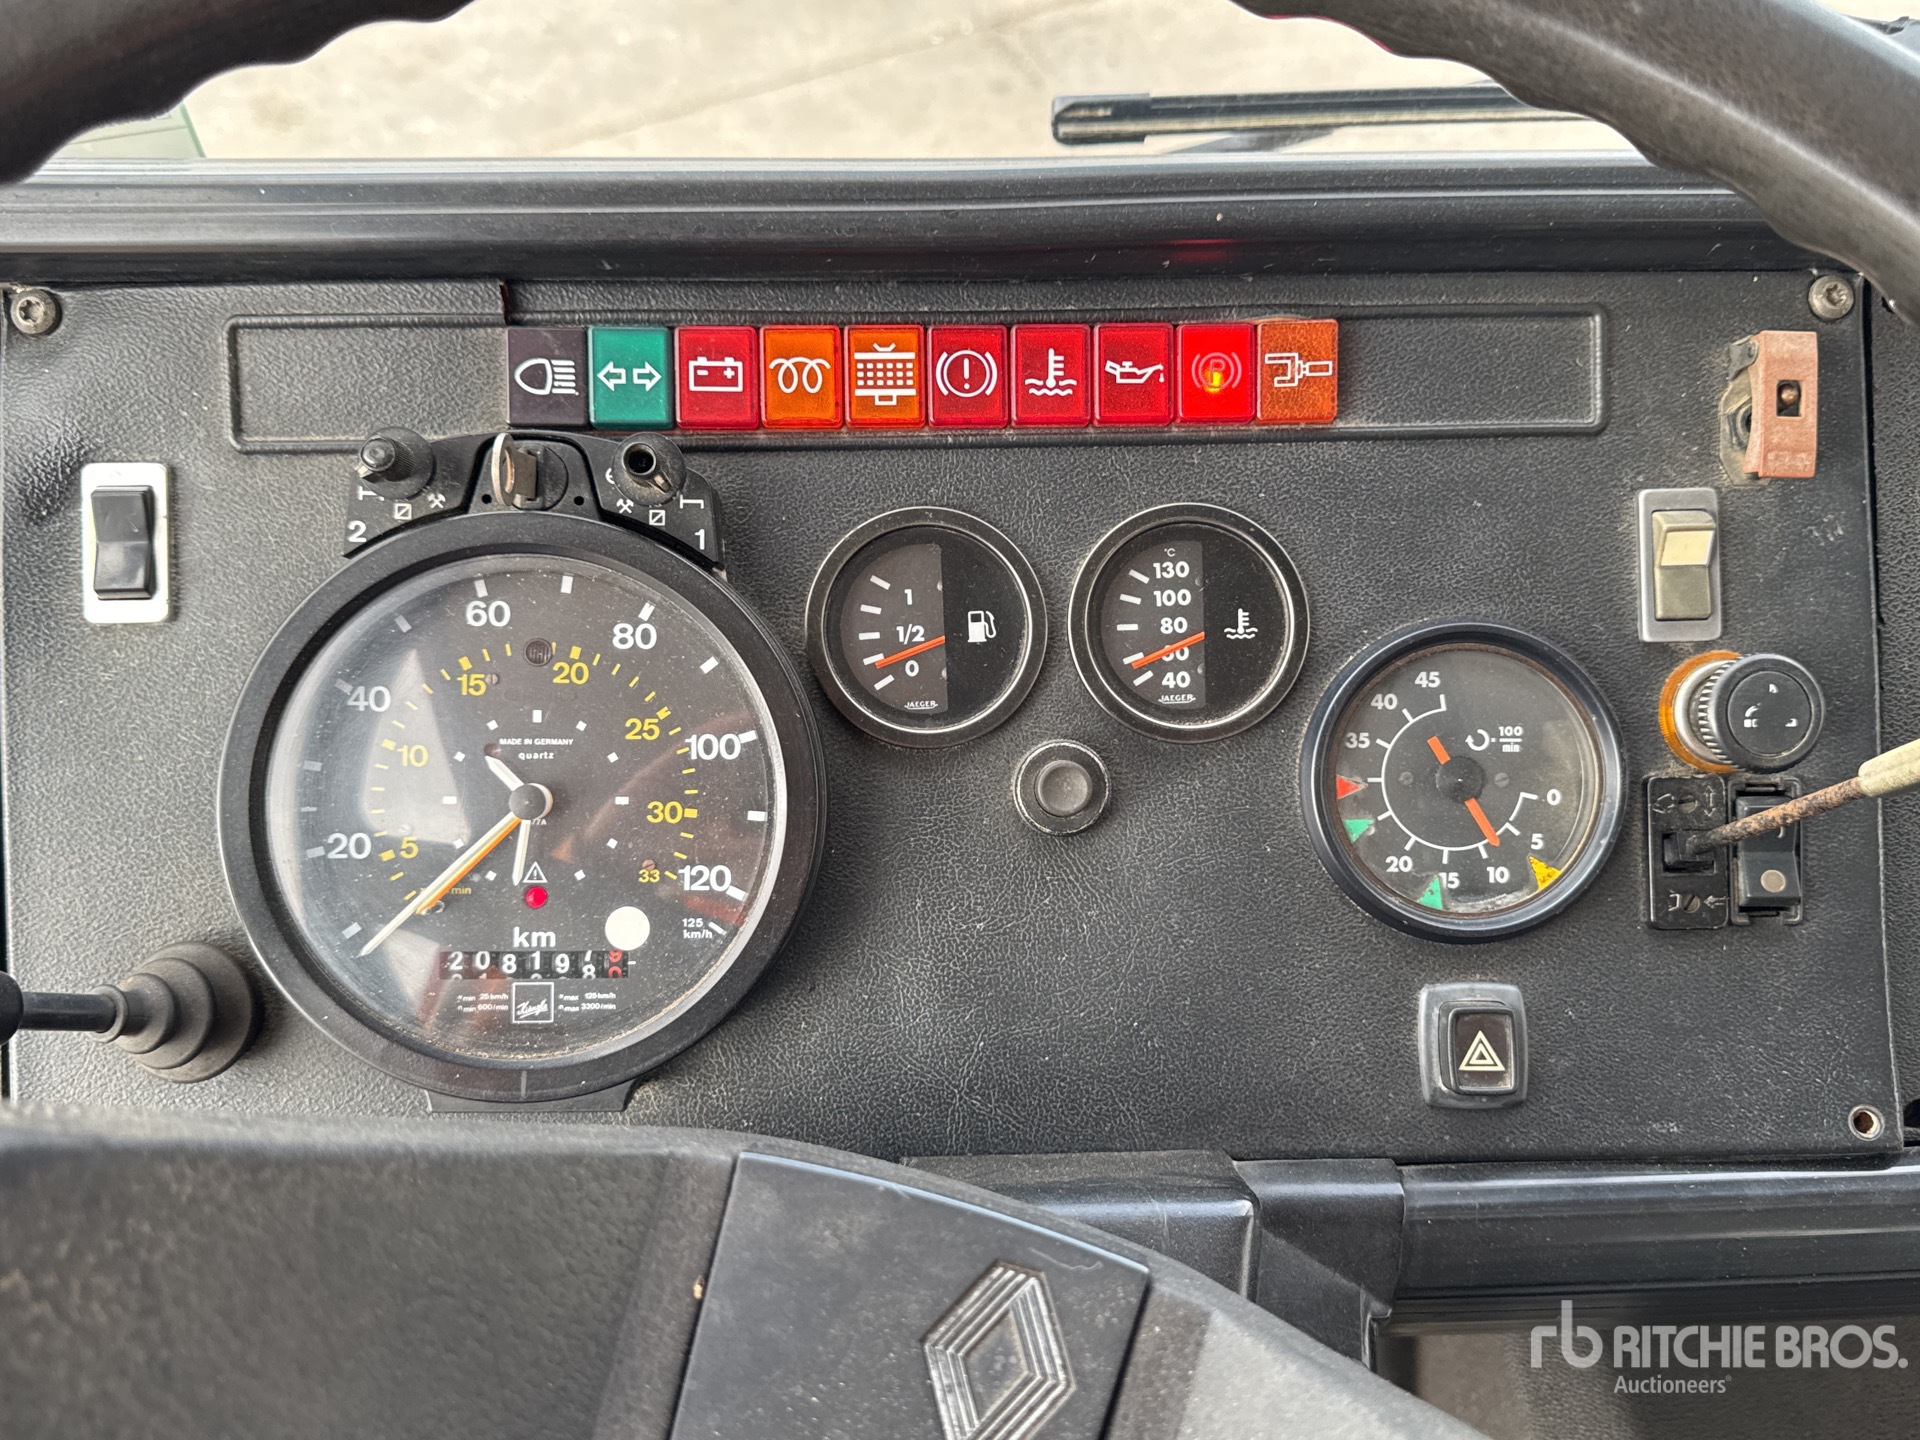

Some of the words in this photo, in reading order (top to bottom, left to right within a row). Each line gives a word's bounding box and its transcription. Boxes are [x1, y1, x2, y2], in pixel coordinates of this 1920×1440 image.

[348, 521, 366, 543] 2
[695, 529, 705, 550] 1
[1153, 561, 1190, 579] 130
[904, 588, 913, 605] 1
[1153, 589, 1192, 607] 100
[466, 601, 511, 627] 60
[896, 624, 925, 644] 1/2
[1160, 617, 1188, 634] 80
[612, 623, 658, 650] 80
[552, 661, 590, 685] 20
[905, 660, 919, 677] 0
[456, 673, 487, 696] 15
[1161, 671, 1191, 689] 40
[1414, 671, 1441, 688] 45
[347, 686, 391, 712] 40
[904, 700, 938, 709] JAEGER
[1158, 694, 1196, 703] JAEGER
[1371, 693, 1398, 710] 40
[625, 718, 660, 740] 25
[1498, 725, 1523, 737] 100
[685, 733, 741, 760] 100
[1345, 733, 1370, 749] 35
[1502, 742, 1520, 753] min
[397, 744, 429, 768] 10
[518, 751, 554, 760] quartz
[1546, 789, 1562, 806] 0
[646, 800, 683, 824] 30
[327, 832, 372, 859] 20
[400, 836, 419, 859] 5
[1530, 833, 1544, 850] 5
[1385, 855, 1413, 873] 20
[638, 868, 661, 883] 33
[678, 865, 732, 892] 120
[1440, 871, 1460, 889] 15
[1487, 866, 1510, 884] 10
[682, 918, 703, 928] 125
[512, 926, 556, 948] km
[683, 929, 713, 939] km/h
